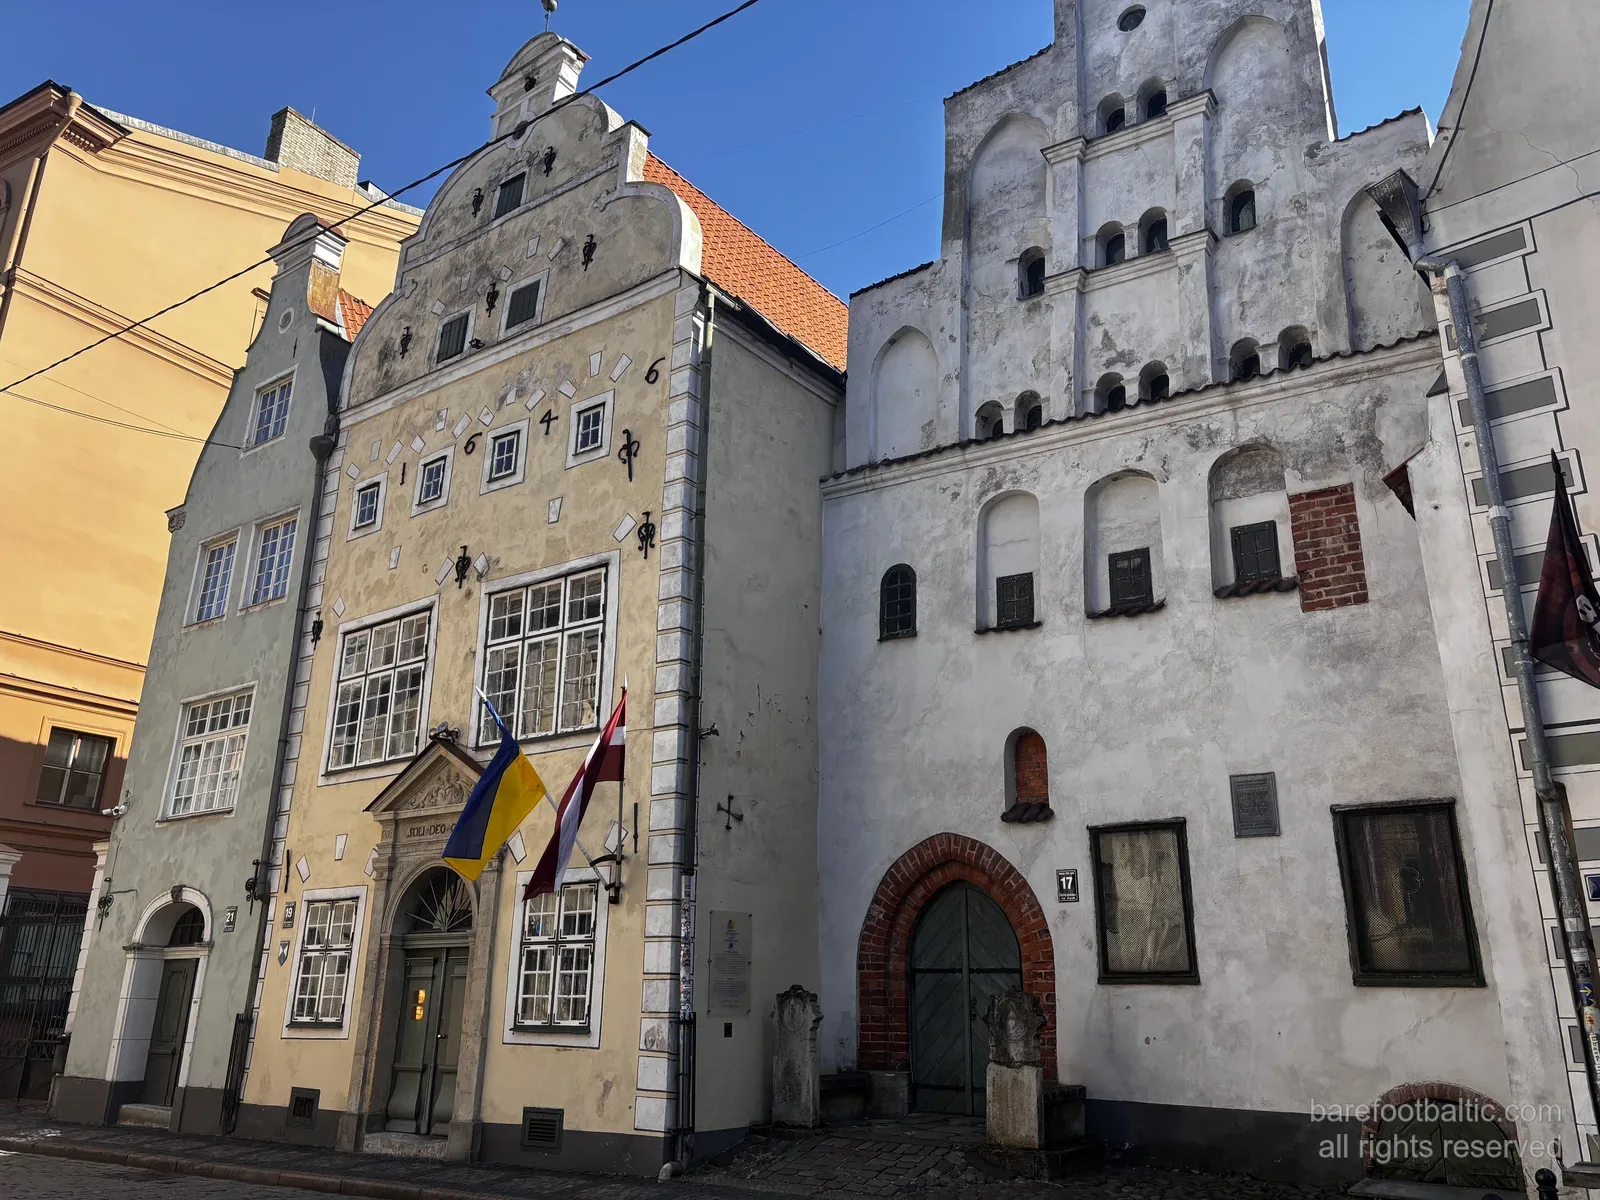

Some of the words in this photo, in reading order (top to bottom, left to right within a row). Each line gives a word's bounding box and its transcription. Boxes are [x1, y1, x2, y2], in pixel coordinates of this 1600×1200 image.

[407, 826, 425, 838] SOLI
[429, 823, 446, 836] DEO
[1060, 876, 1073, 890] 17
[225, 911, 235, 923] 21
[285, 907, 293, 918] 19
